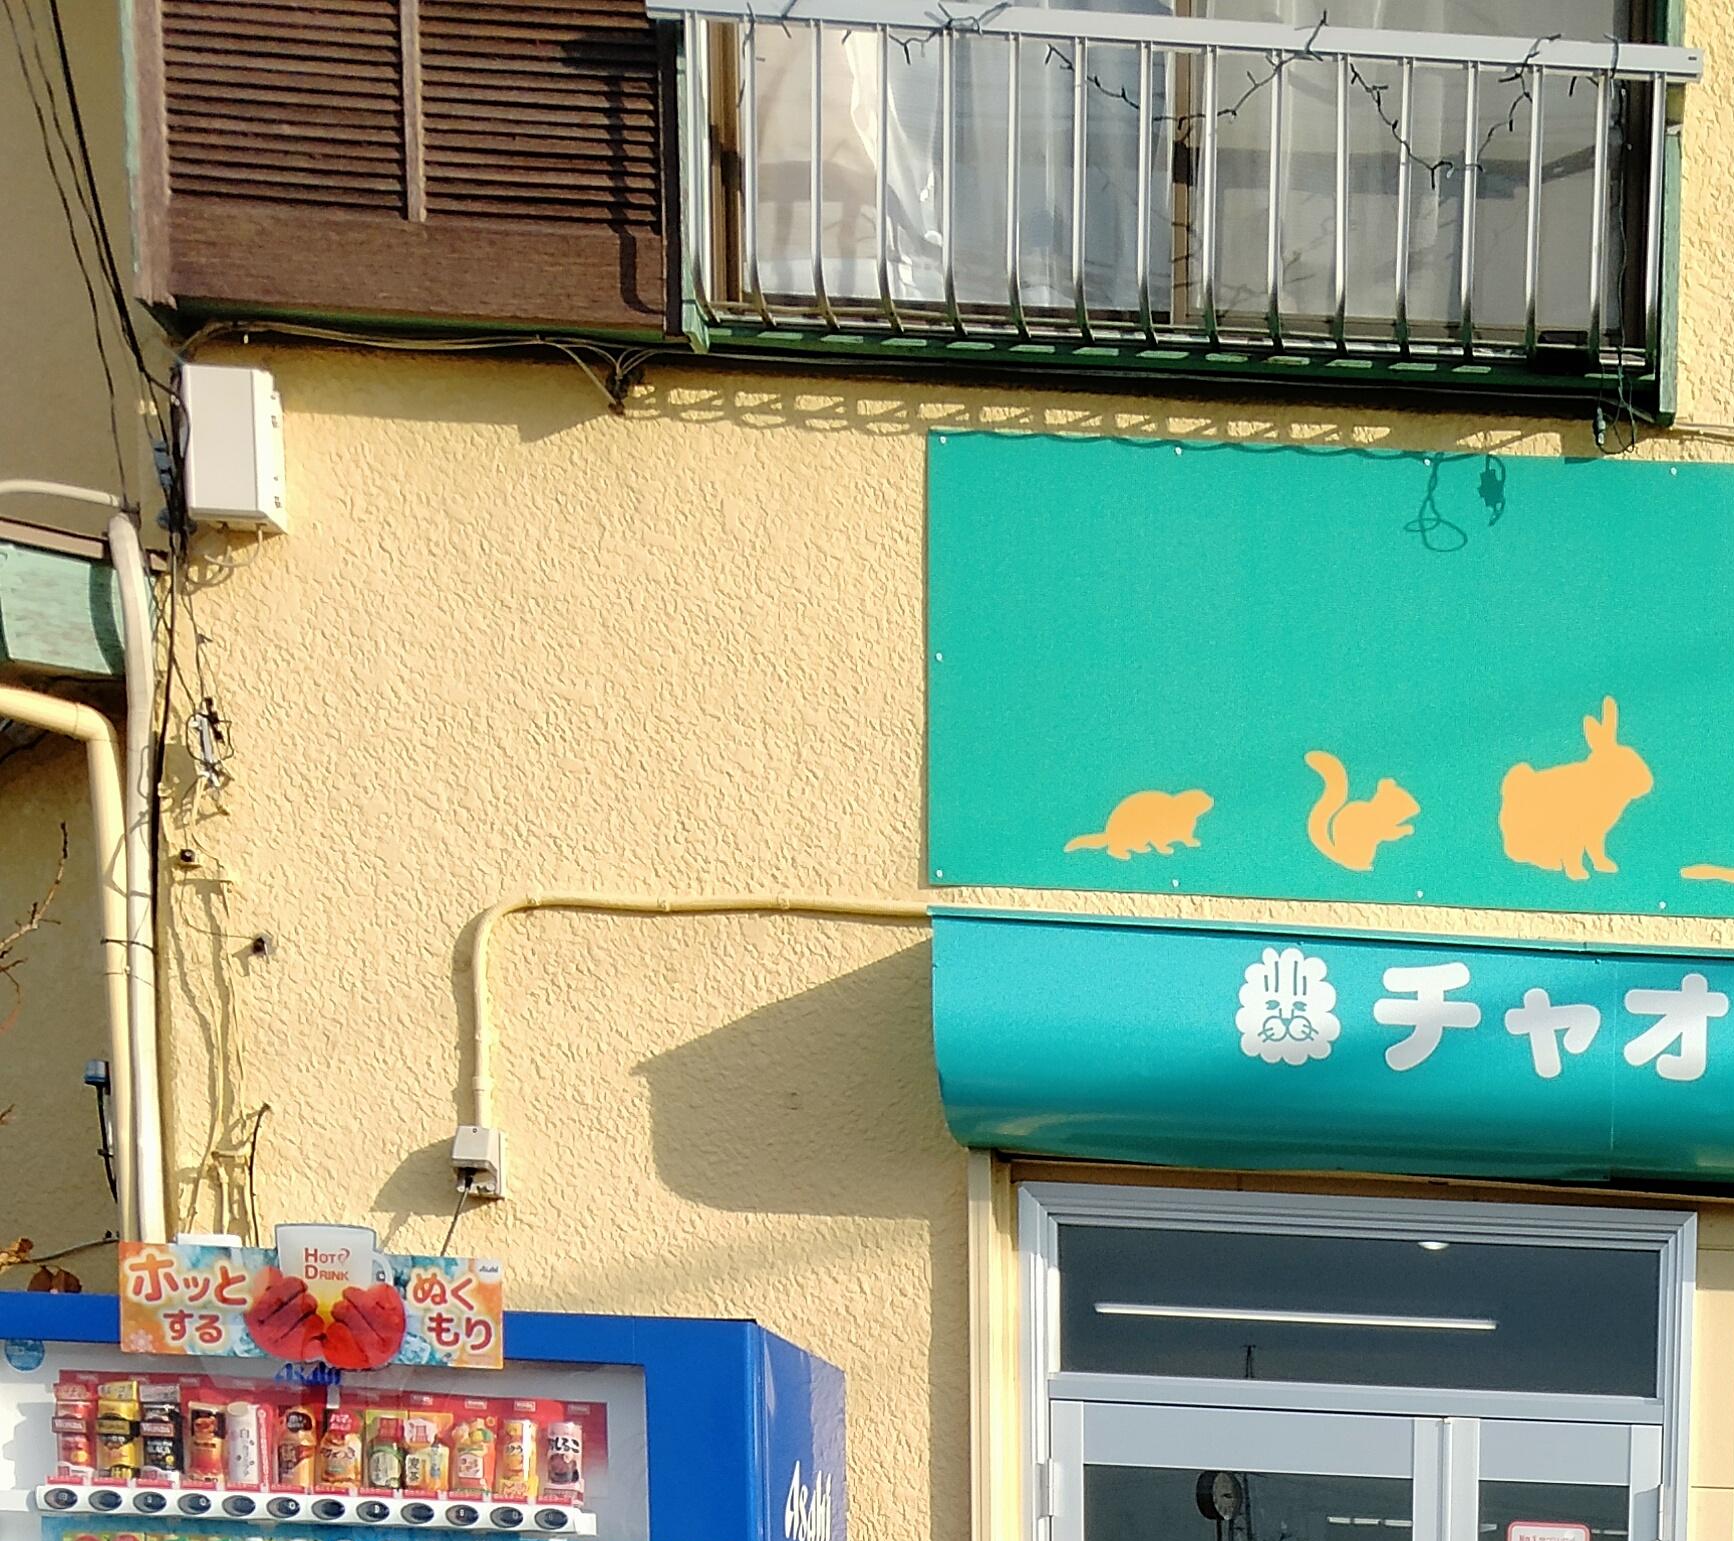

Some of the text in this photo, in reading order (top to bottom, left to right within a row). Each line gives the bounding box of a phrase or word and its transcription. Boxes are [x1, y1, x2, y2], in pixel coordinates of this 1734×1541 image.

[128, 1253, 248, 1307] ホッと
[411, 1271, 475, 1312] ぬく
[162, 1310, 224, 1345] する
[427, 1312, 493, 1352] もり
